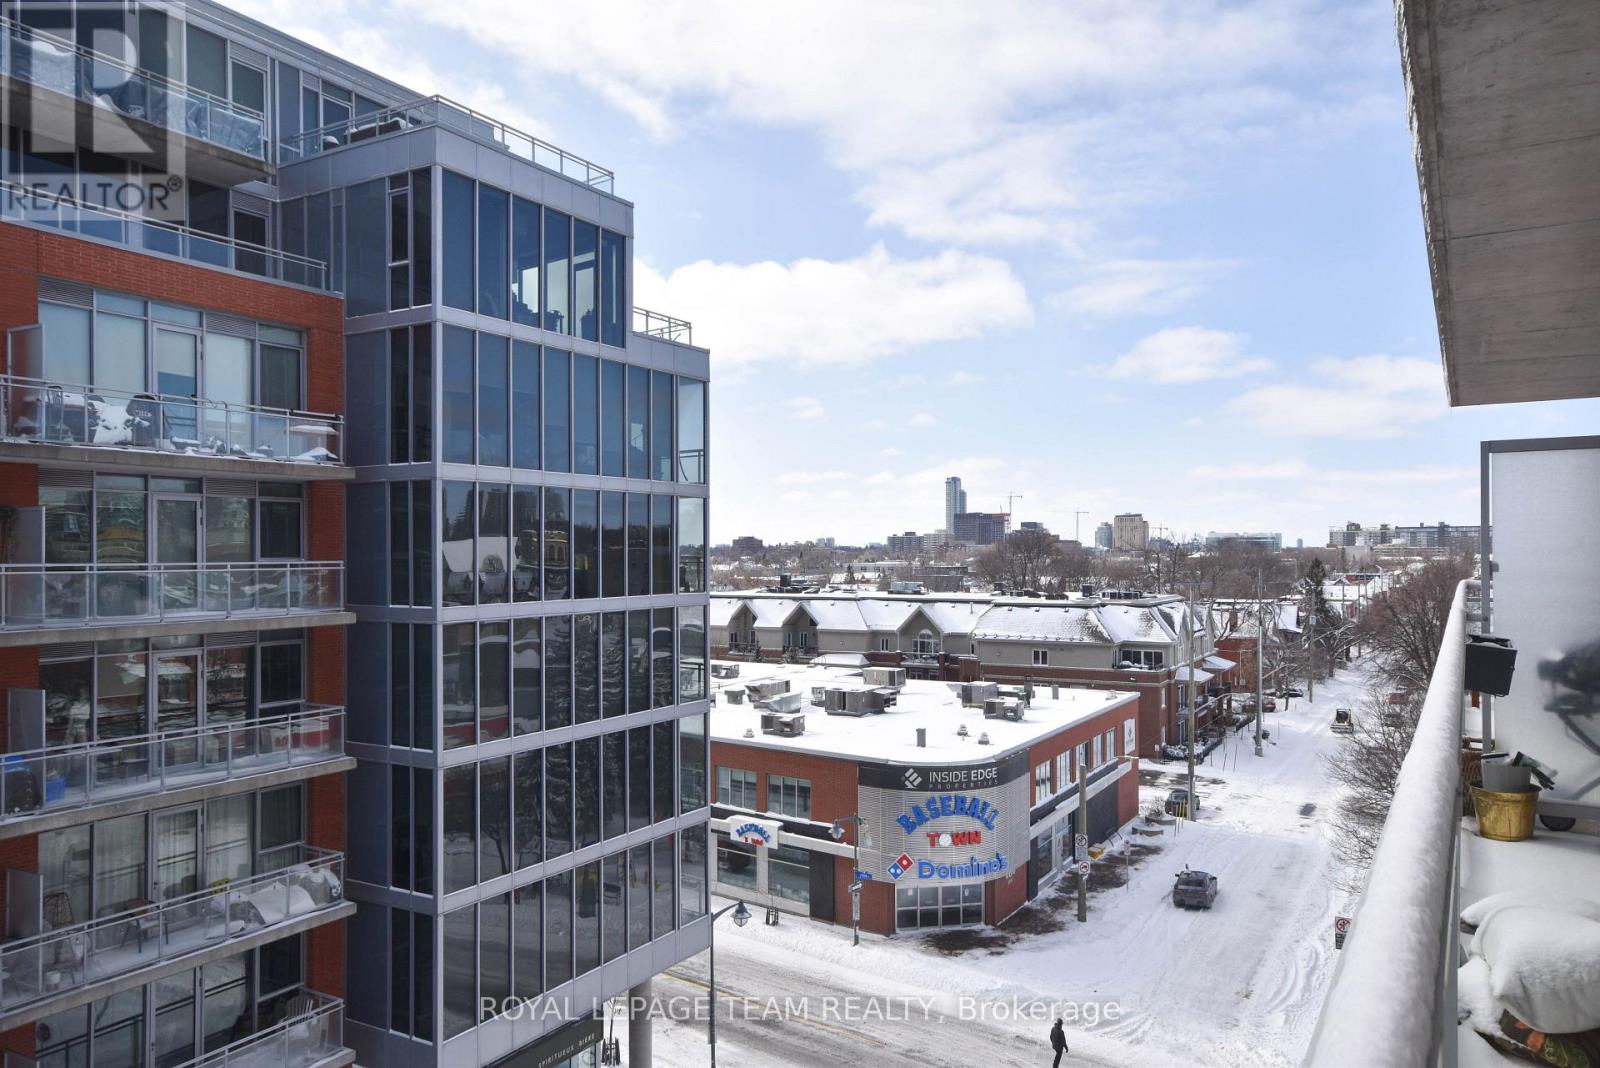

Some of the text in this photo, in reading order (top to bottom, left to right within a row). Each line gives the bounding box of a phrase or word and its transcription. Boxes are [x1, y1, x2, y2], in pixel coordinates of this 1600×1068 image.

[929, 767, 998, 783] INSIDE EDGE
[929, 779, 998, 790] PROPERTIES
[896, 794, 1000, 835] BASEBALL
[926, 830, 982, 848] TOWN
[917, 851, 1009, 880] Domino's
